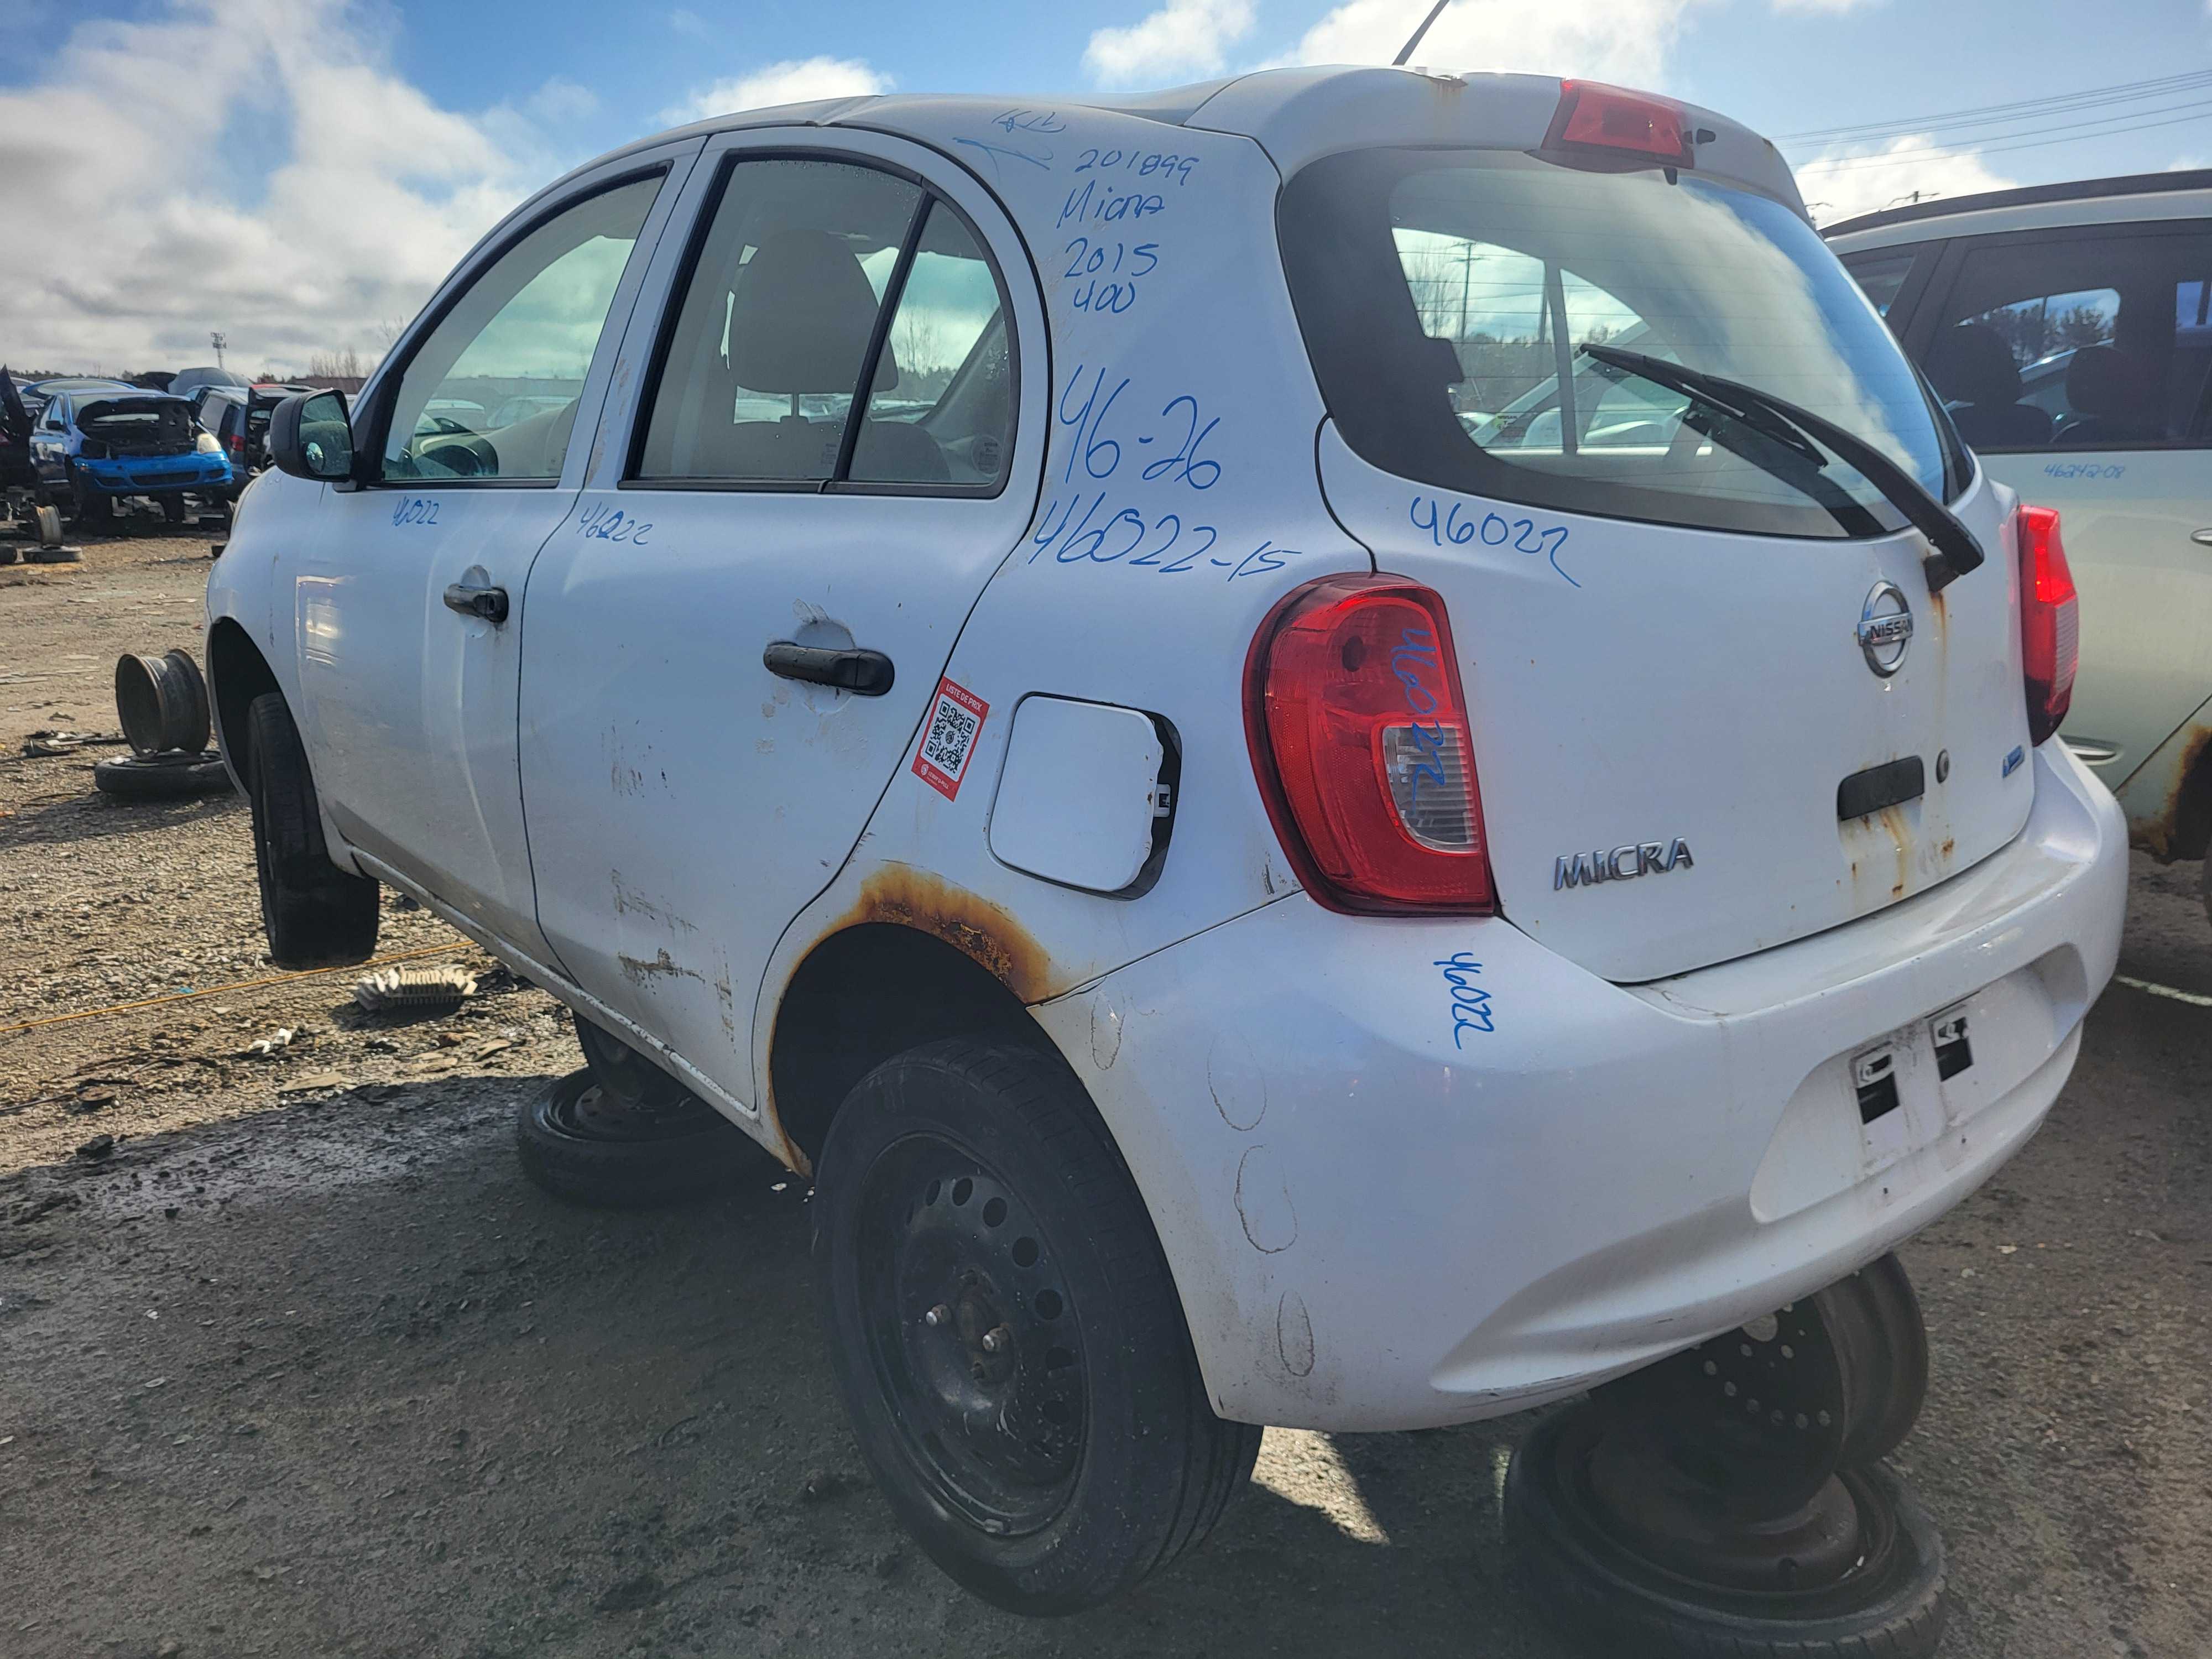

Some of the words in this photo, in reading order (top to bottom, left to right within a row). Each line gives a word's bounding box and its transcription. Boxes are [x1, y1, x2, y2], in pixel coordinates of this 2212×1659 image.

[1075, 149, 1199, 186] 201899
[1064, 238, 1160, 278] 2015
[1060, 364, 1221, 490] 46-26
[1027, 491, 1303, 582] 46022-15
[1410, 497, 1582, 588] 46022
[946, 683, 961, 698] LISTE
[960, 692, 969, 704] DE
[968, 697, 982, 712] PRIX
[1554, 837, 1694, 890] MICRA
